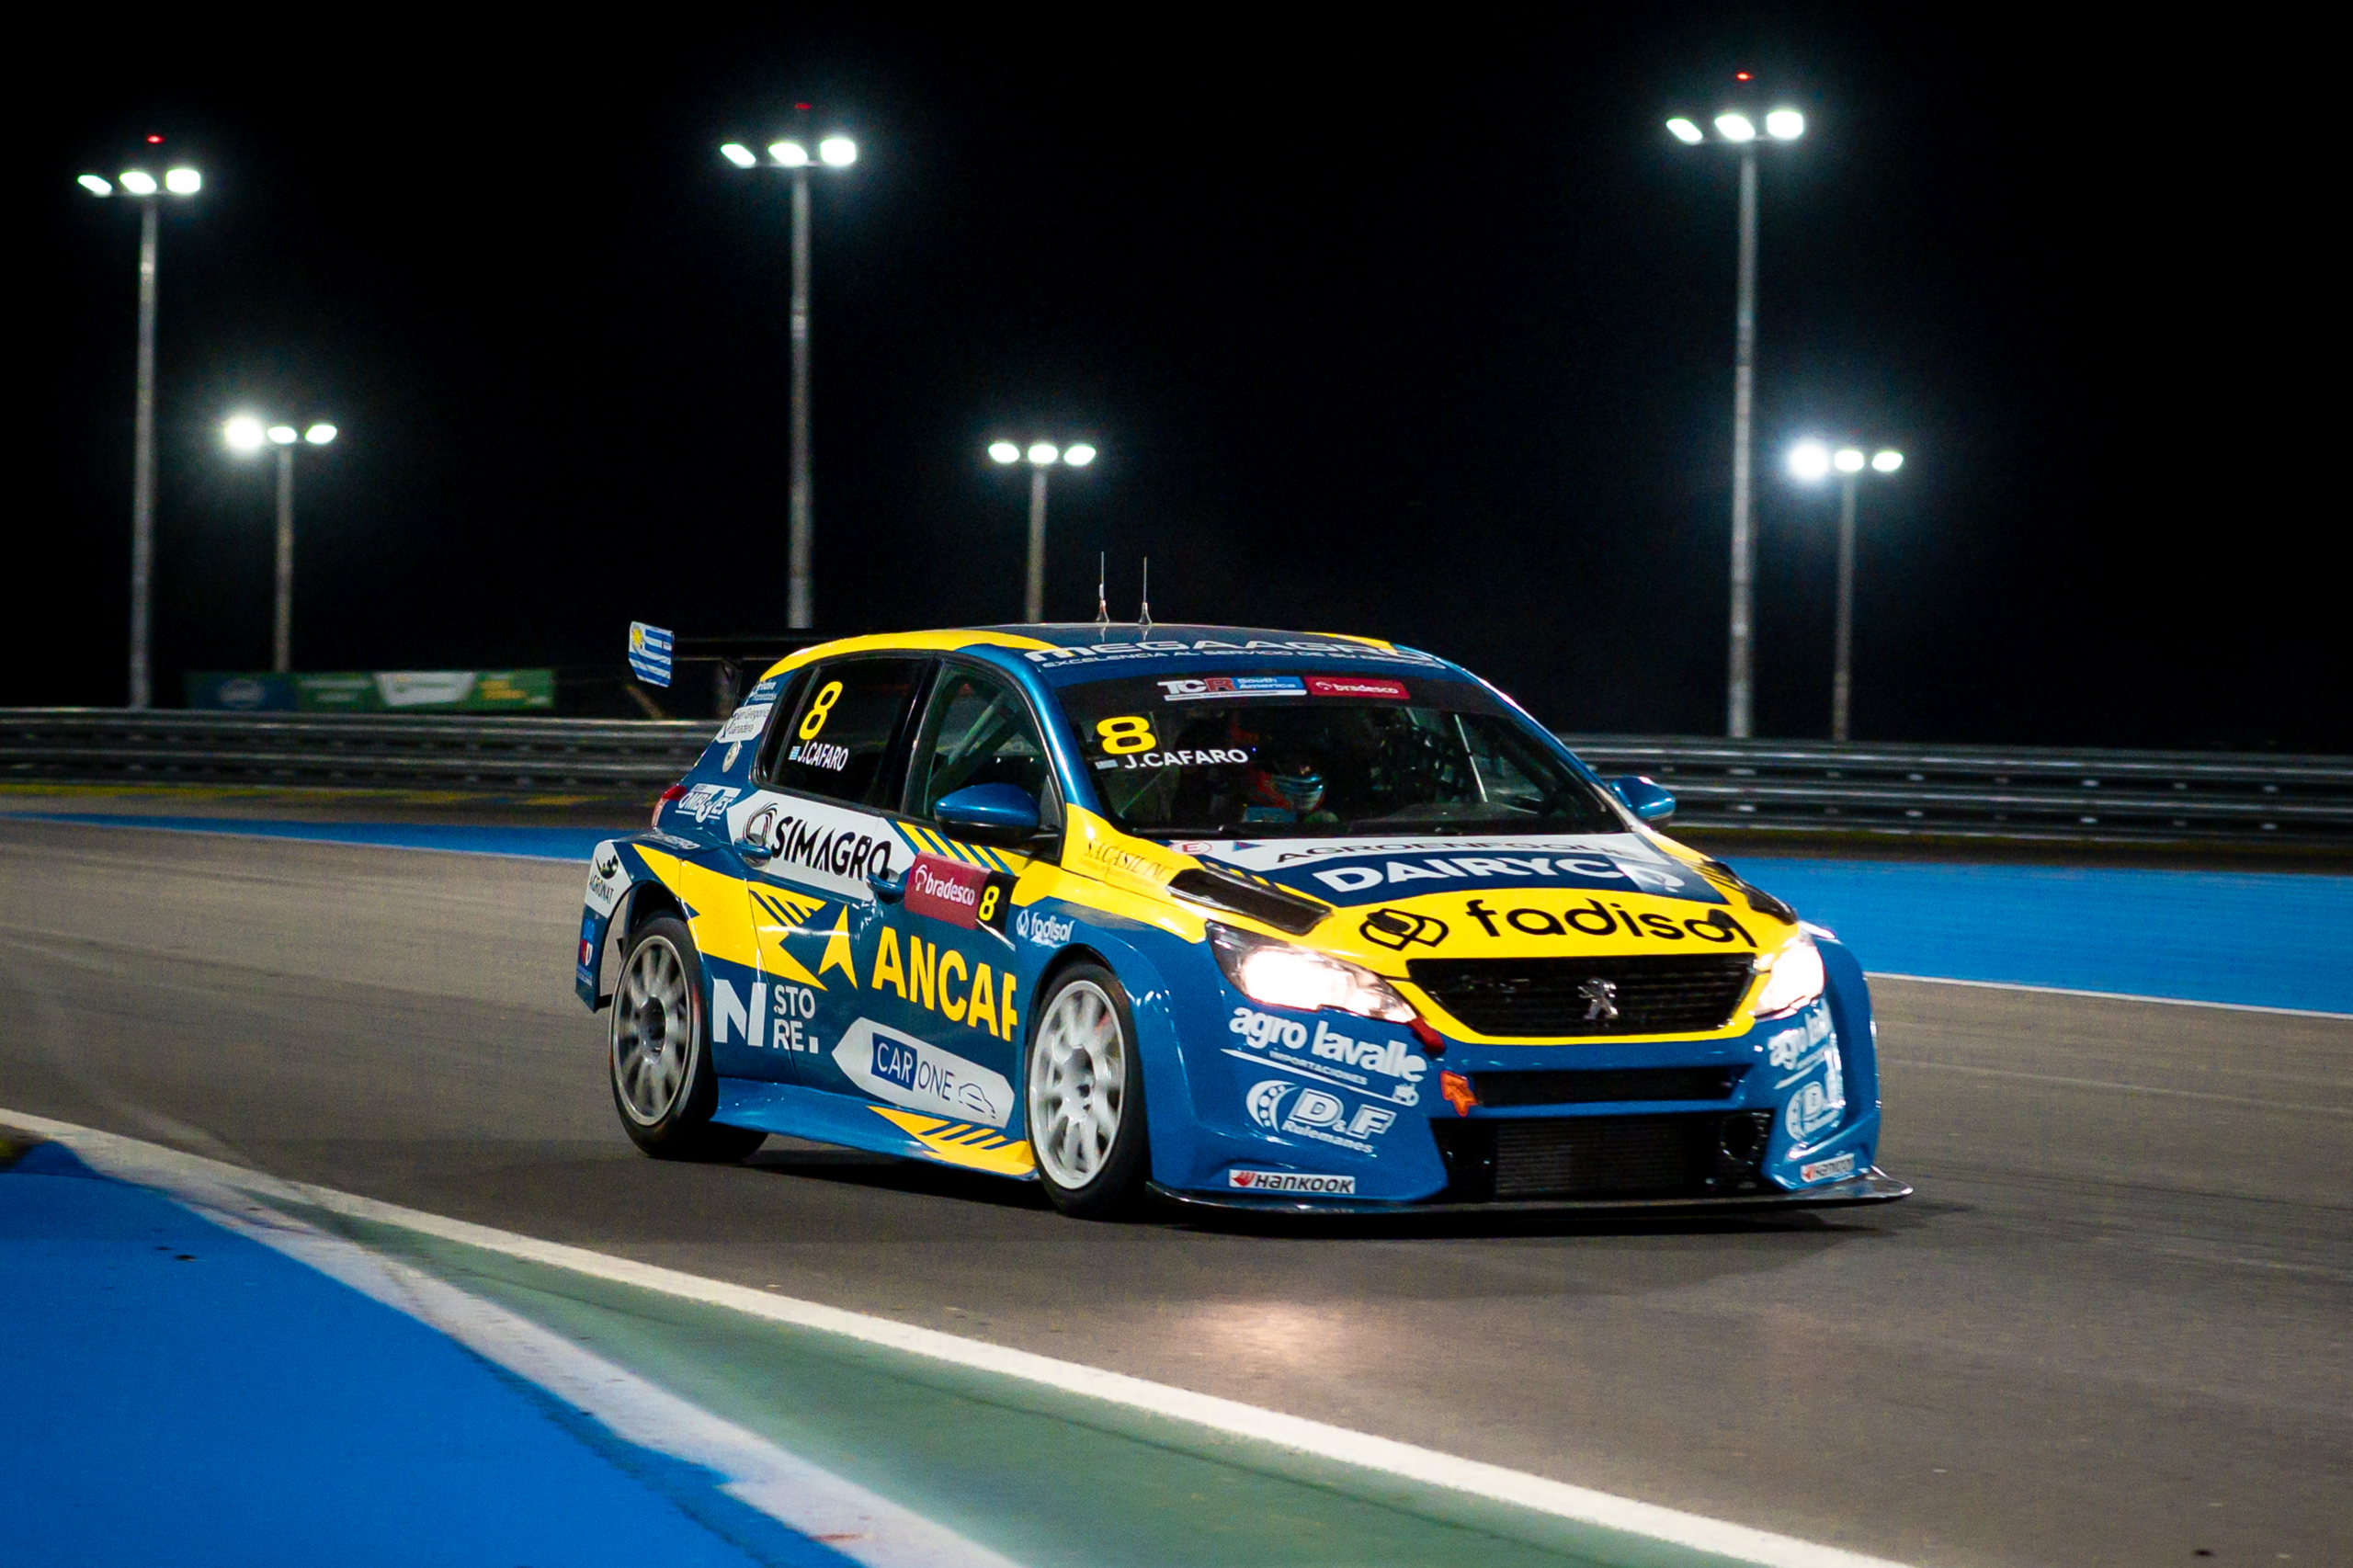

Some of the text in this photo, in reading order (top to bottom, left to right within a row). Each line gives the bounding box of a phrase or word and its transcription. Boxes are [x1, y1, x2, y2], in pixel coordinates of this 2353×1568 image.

[1025, 641, 1436, 664] MEGAAGRO
[1042, 652, 1168, 668] EXCELENCIA
[1157, 677, 1236, 695] TCR
[1333, 683, 1399, 695] bradesco
[799, 681, 844, 740] 8
[1097, 716, 1156, 755] 8
[797, 741, 848, 772] J.CAFARO
[1124, 749, 1249, 769] J.CAFARO
[771, 815, 892, 881] SIMAGRO
[926, 872, 975, 907] bradesco
[978, 885, 1000, 922] 8
[1030, 911, 1075, 942] fadisol
[1466, 897, 1758, 949] fadisol
[774, 984, 816, 1019] STO
[1229, 1006, 1427, 1083] agro lavalle
[877, 1042, 956, 1102] CAR ONE
[1269, 1051, 1369, 1085] IMPORTACIONES
[1287, 1087, 1397, 1140] D&F
[1281, 1119, 1374, 1153] Rulemanes
